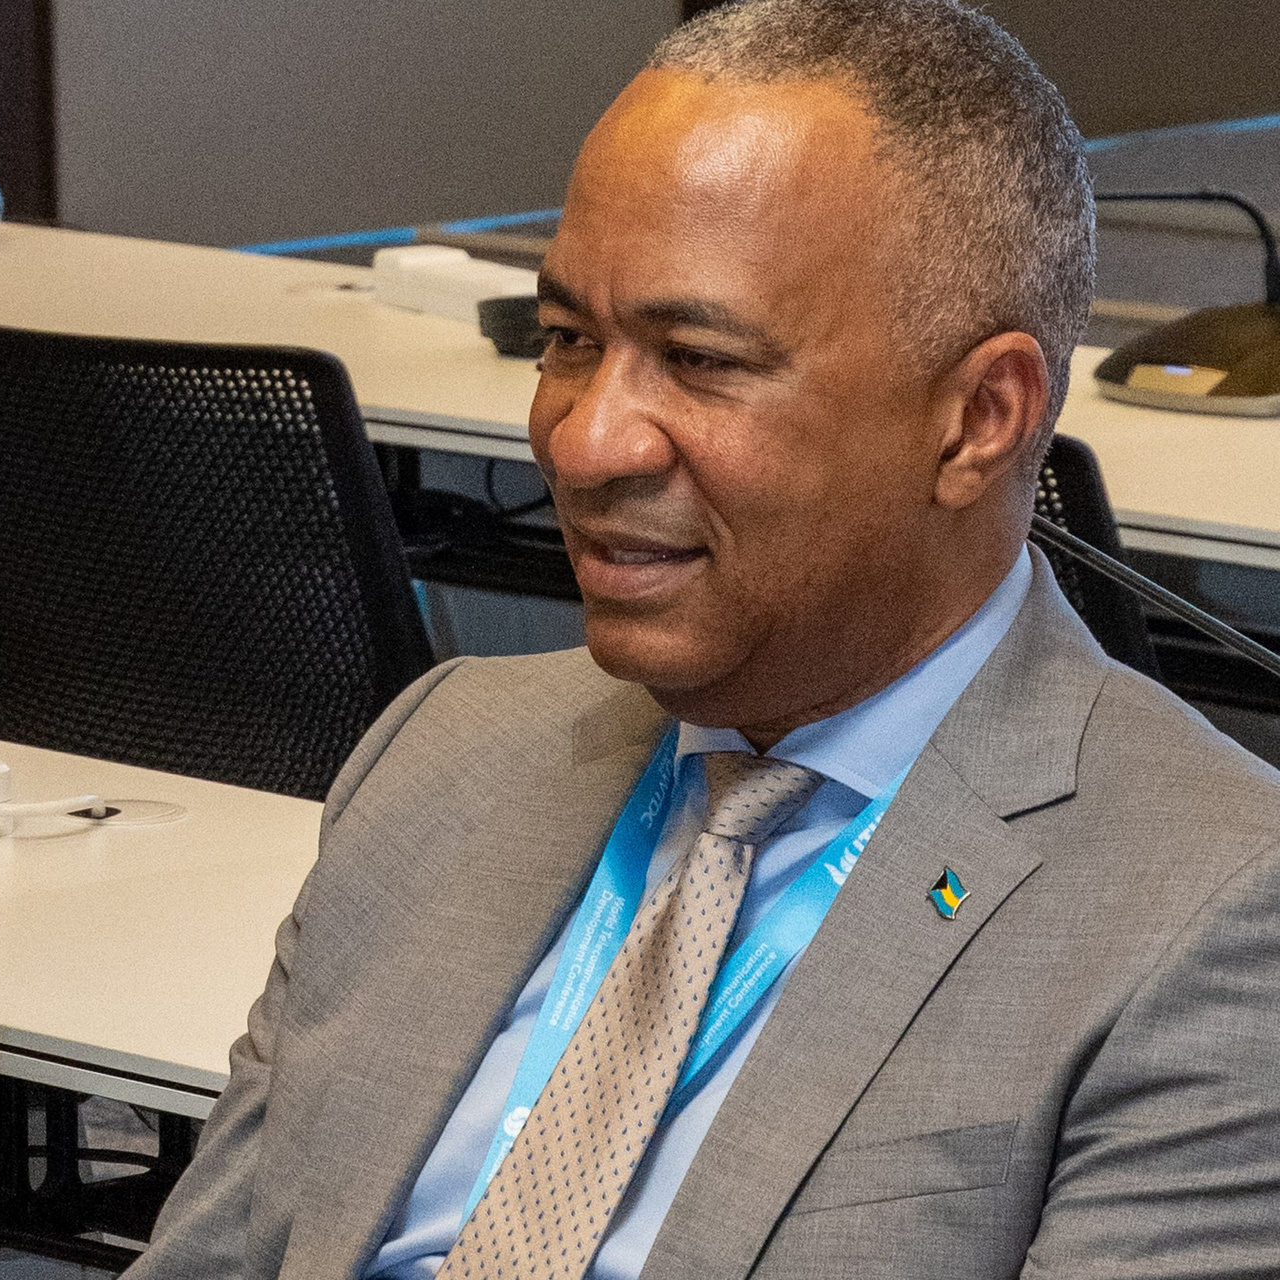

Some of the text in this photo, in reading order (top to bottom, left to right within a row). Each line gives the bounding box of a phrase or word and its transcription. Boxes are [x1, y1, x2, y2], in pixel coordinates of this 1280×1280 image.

[549, 890, 614, 1027] Development Conference
[562, 896, 626, 1031] World Telecommunication
[728, 951, 777, 1008] Conference
